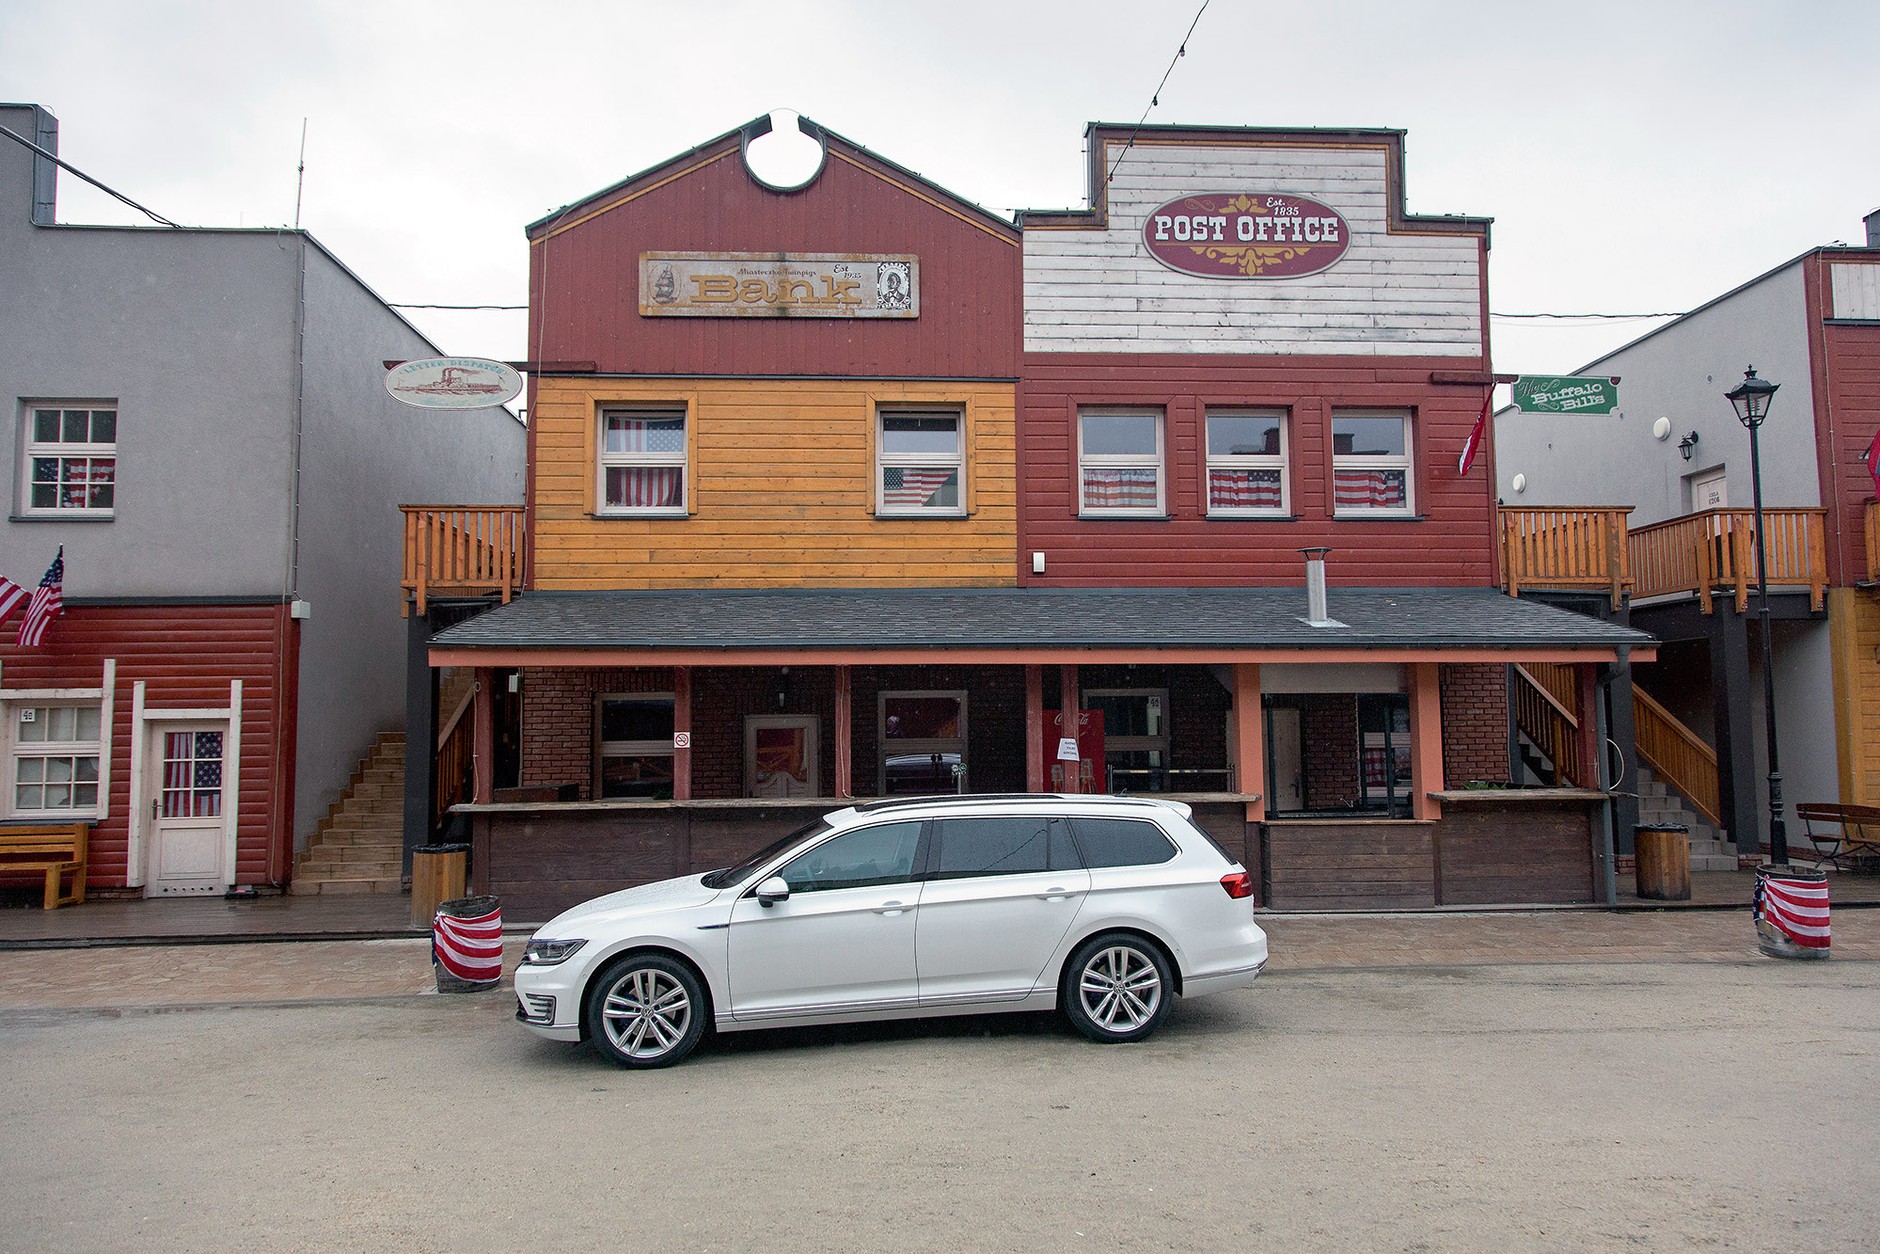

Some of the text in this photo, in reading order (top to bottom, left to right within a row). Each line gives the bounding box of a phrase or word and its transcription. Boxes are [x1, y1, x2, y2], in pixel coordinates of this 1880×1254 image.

[1266, 197, 1286, 208] Est.
[1274, 207, 1300, 216] 1835
[1154, 215, 1340, 243] POST OFFICE
[690, 274, 863, 305] Bank
[404, 359, 506, 375] LETTER DISPATCH
[1530, 383, 1603, 405] Buffalo
